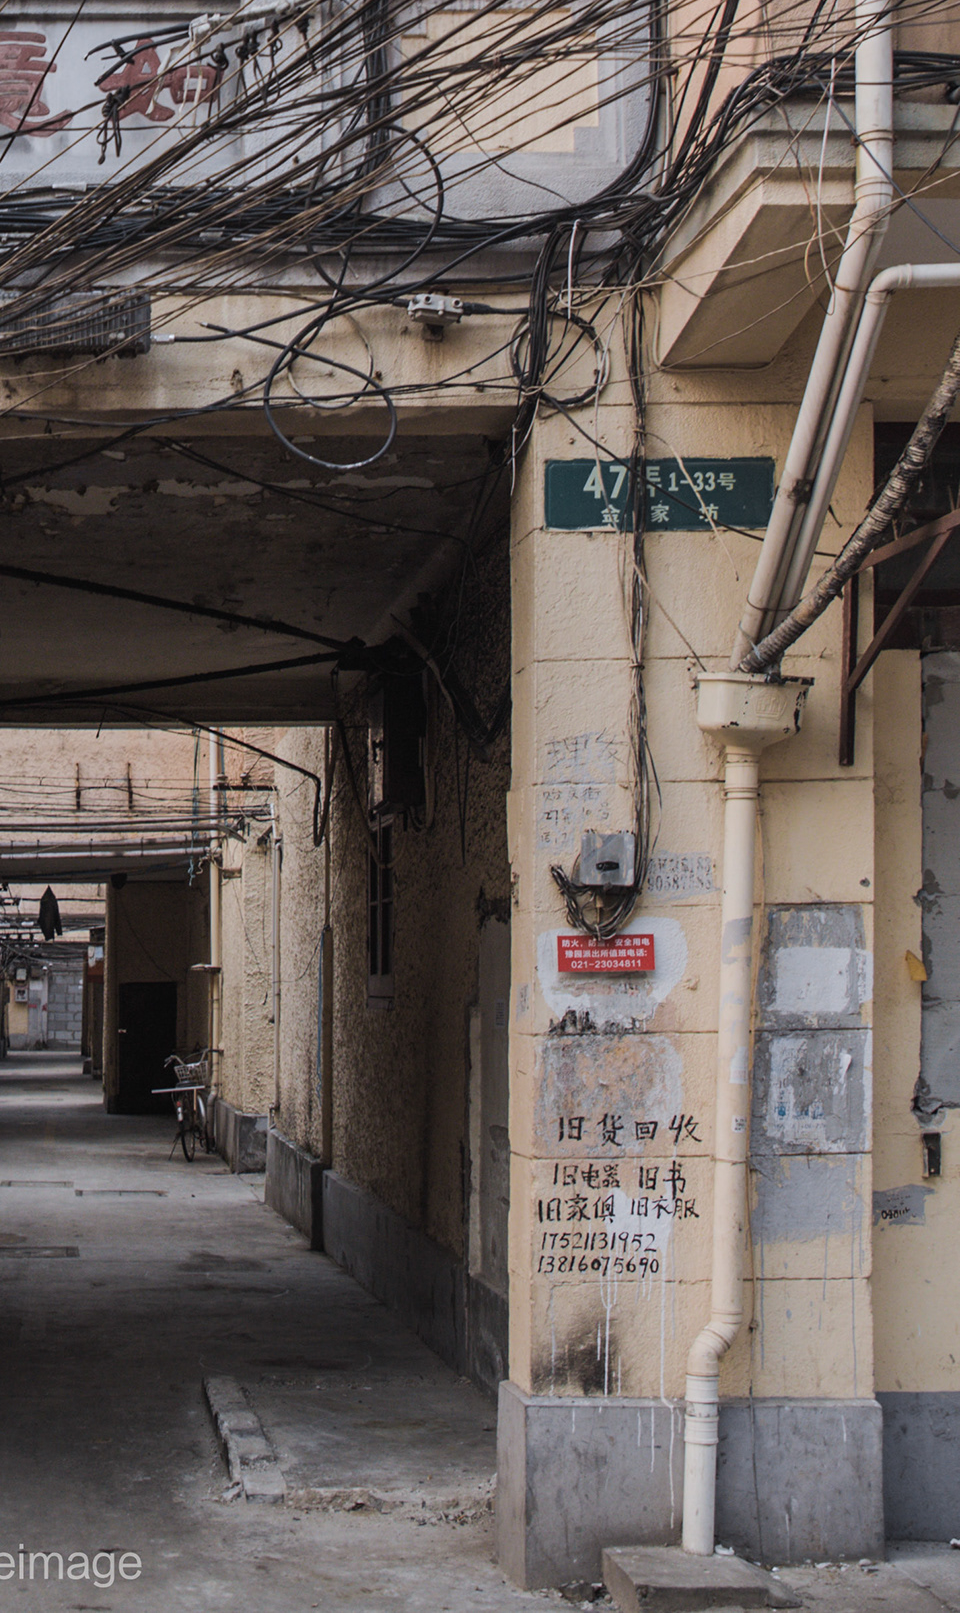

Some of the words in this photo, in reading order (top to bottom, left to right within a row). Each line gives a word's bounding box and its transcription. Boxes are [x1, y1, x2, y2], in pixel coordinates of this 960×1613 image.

[668, 472, 737, 492] 1-33号
[601, 503, 719, 523] 金家坊
[571, 959, 641, 969] 021-23034811
[558, 1113, 703, 1147] 旧货回收
[553, 1163, 621, 1189] 旧电器
[639, 1160, 686, 1199] 旧书
[630, 1195, 700, 1220] 旧衣服
[541, 1232, 657, 1252] 17521131952
[537, 1255, 660, 1278] 13816075690
